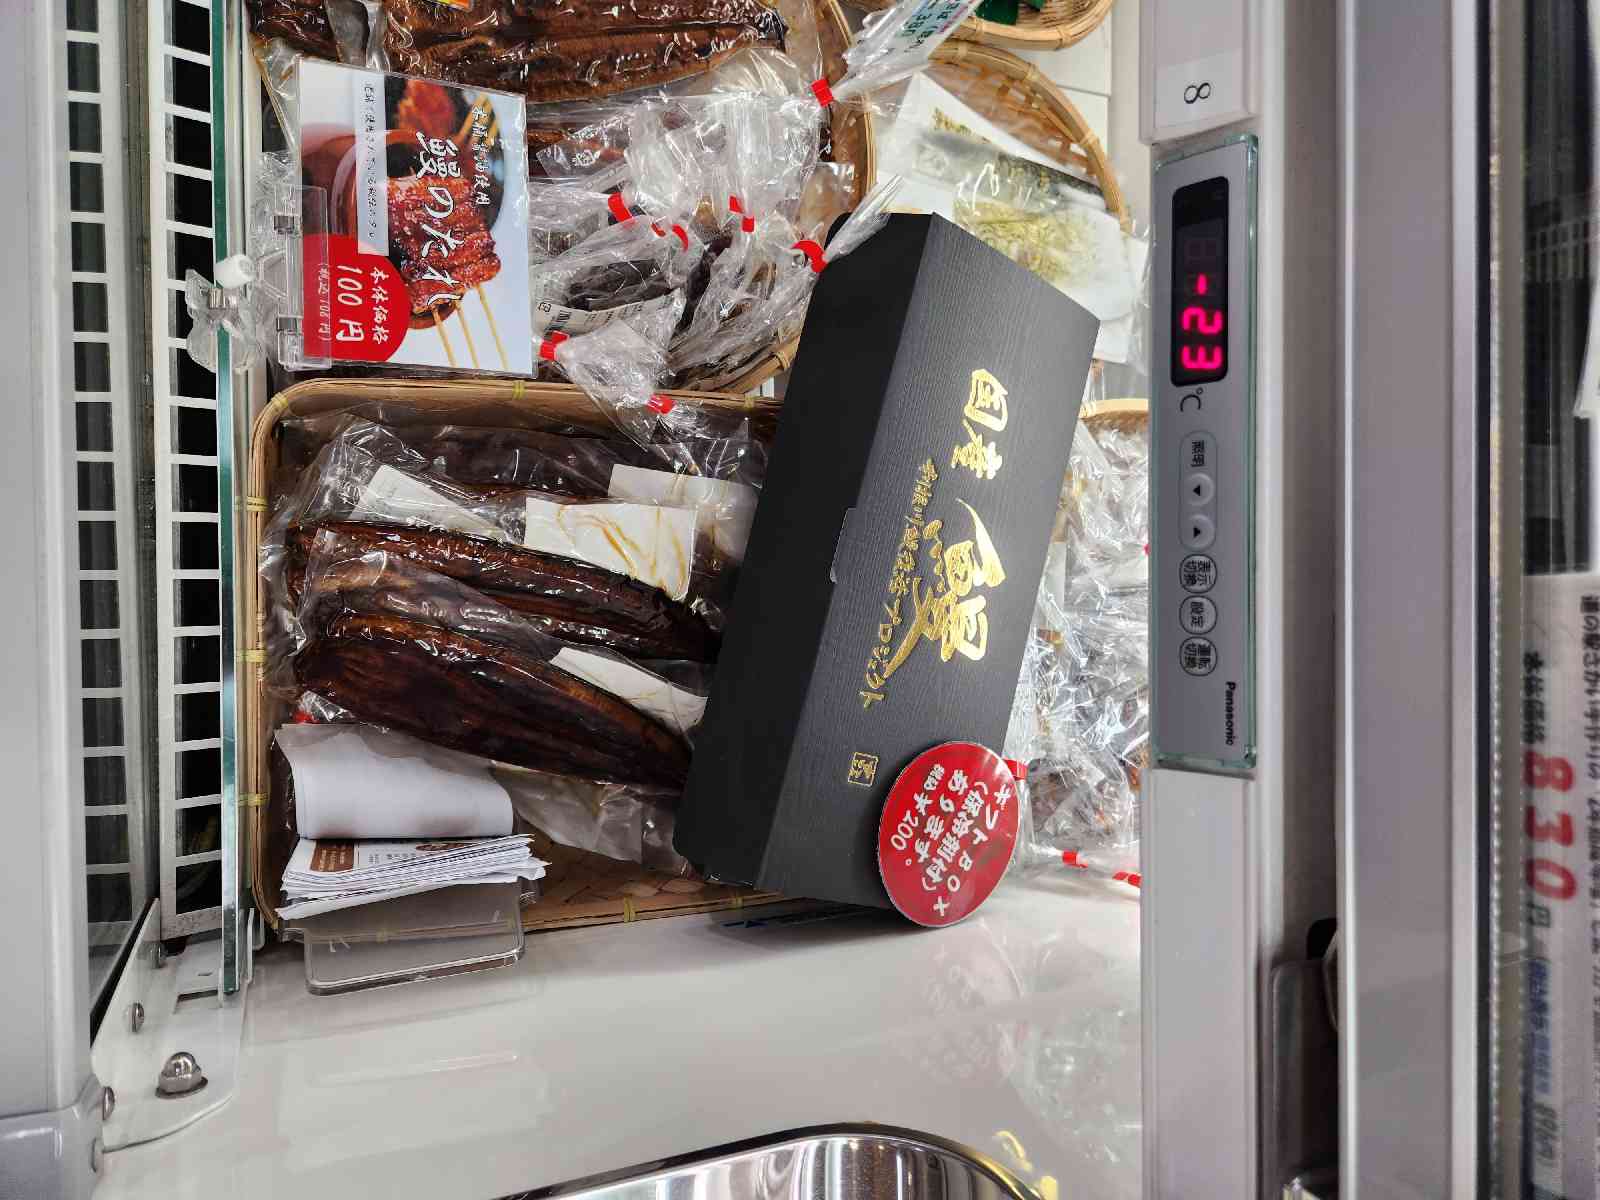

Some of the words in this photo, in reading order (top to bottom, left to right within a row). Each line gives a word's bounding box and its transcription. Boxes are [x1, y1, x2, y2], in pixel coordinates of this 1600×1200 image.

[1184, 80, 1213, 105] 8
[415, 131, 463, 306] 鰻のたれ
[337, 263, 363, 306] 100
[371, 266, 389, 345] 本体価格
[1181, 273, 1223, 372] -23
[335, 318, 364, 343] 円
[951, 369, 1008, 480] 国産
[1190, 440, 1206, 467] 照明
[883, 499, 1007, 676] 鰻
[1184, 560, 1197, 587] 切換
[1197, 560, 1211, 587] 表示
[1190, 602, 1204, 628] 設定
[1184, 643, 1197, 670] 切換
[1197, 644, 1211, 670] 運転
[1224, 681, 1236, 746] Panasonic
[904, 769, 969, 867] あります。
[1524, 750, 1578, 901] 830
[1526, 904, 1551, 928] 円
